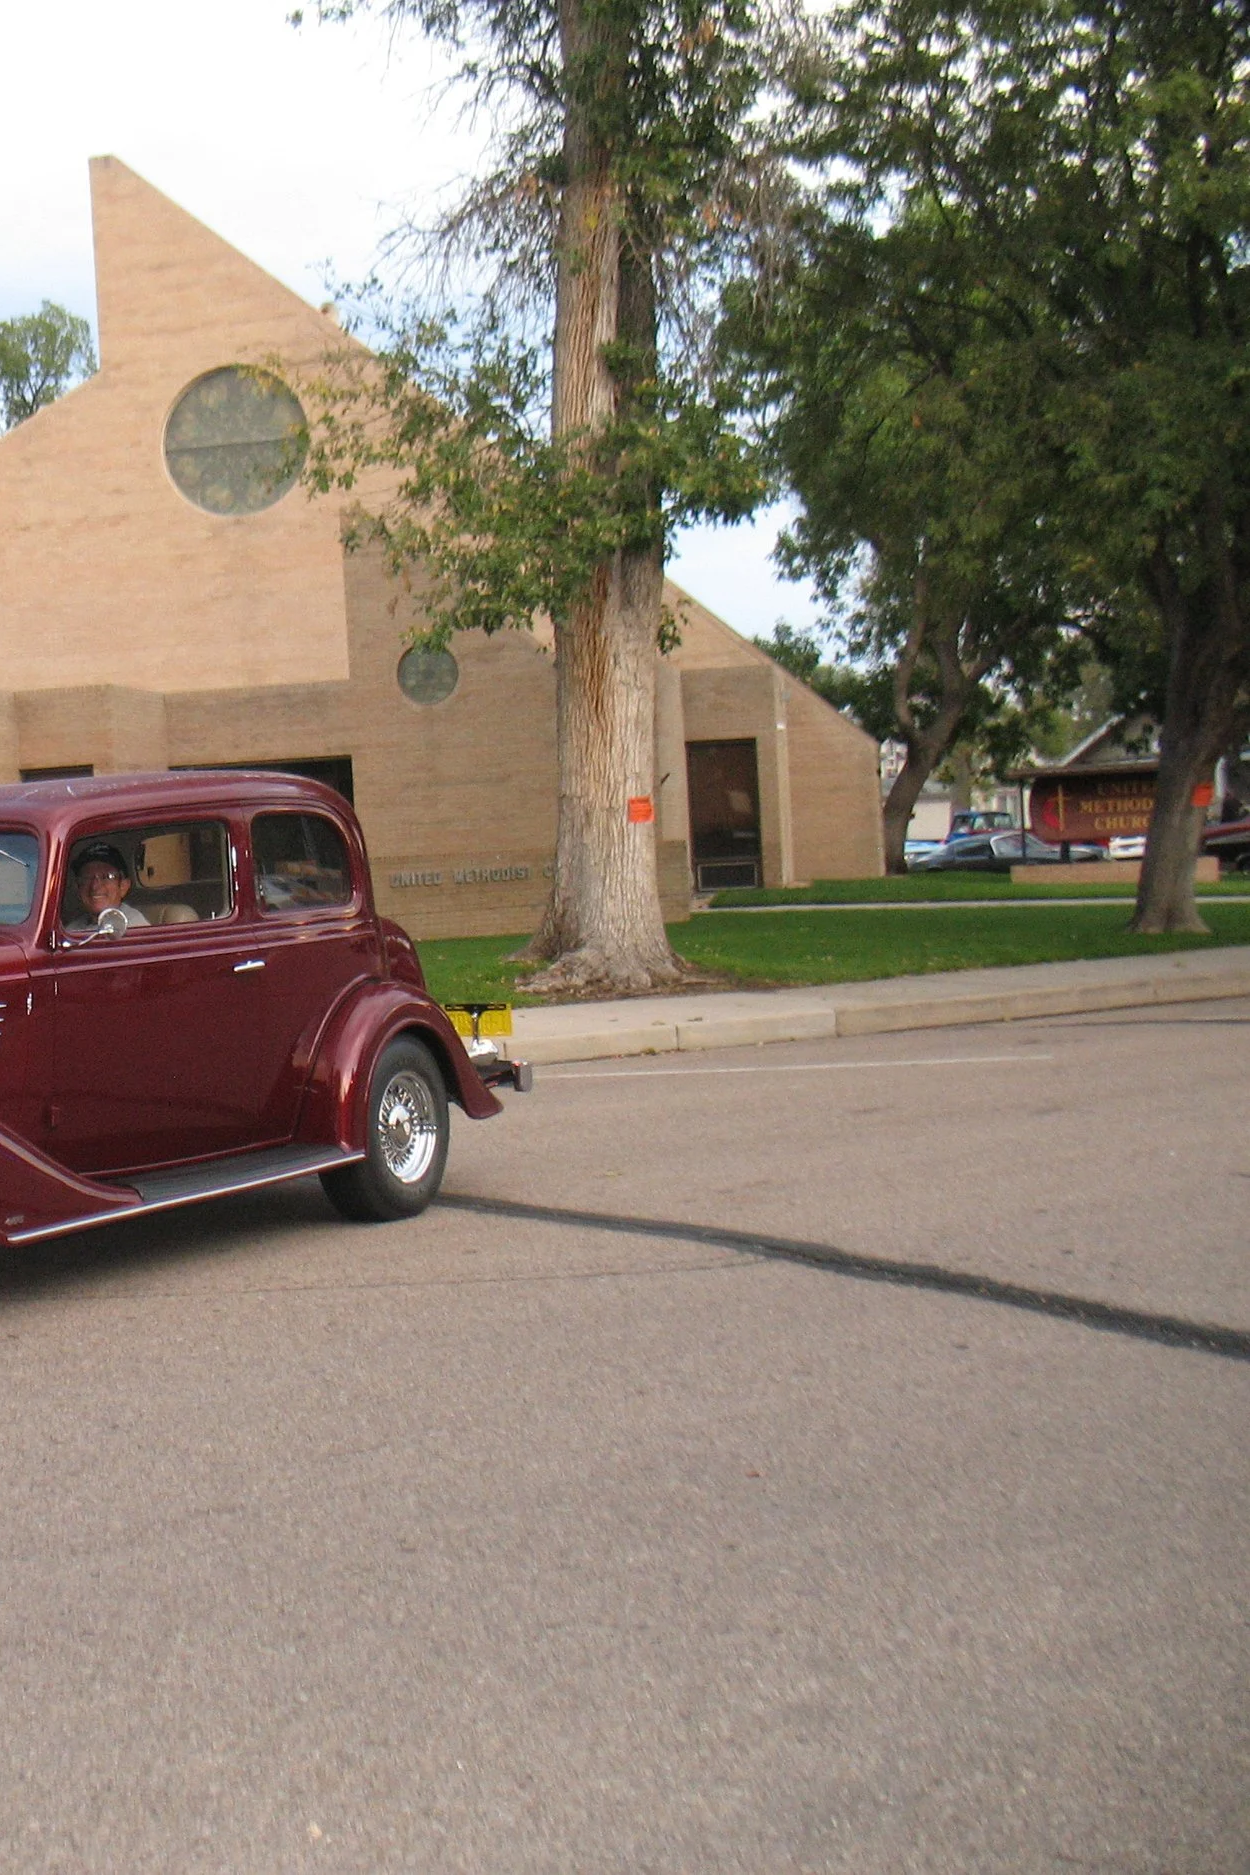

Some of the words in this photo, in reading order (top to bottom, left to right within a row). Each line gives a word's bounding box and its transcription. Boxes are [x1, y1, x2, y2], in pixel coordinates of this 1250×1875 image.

[1080, 798, 1153, 812] METHOD
[390, 871, 443, 888] UNITED
[453, 866, 534, 885] METHODIST
